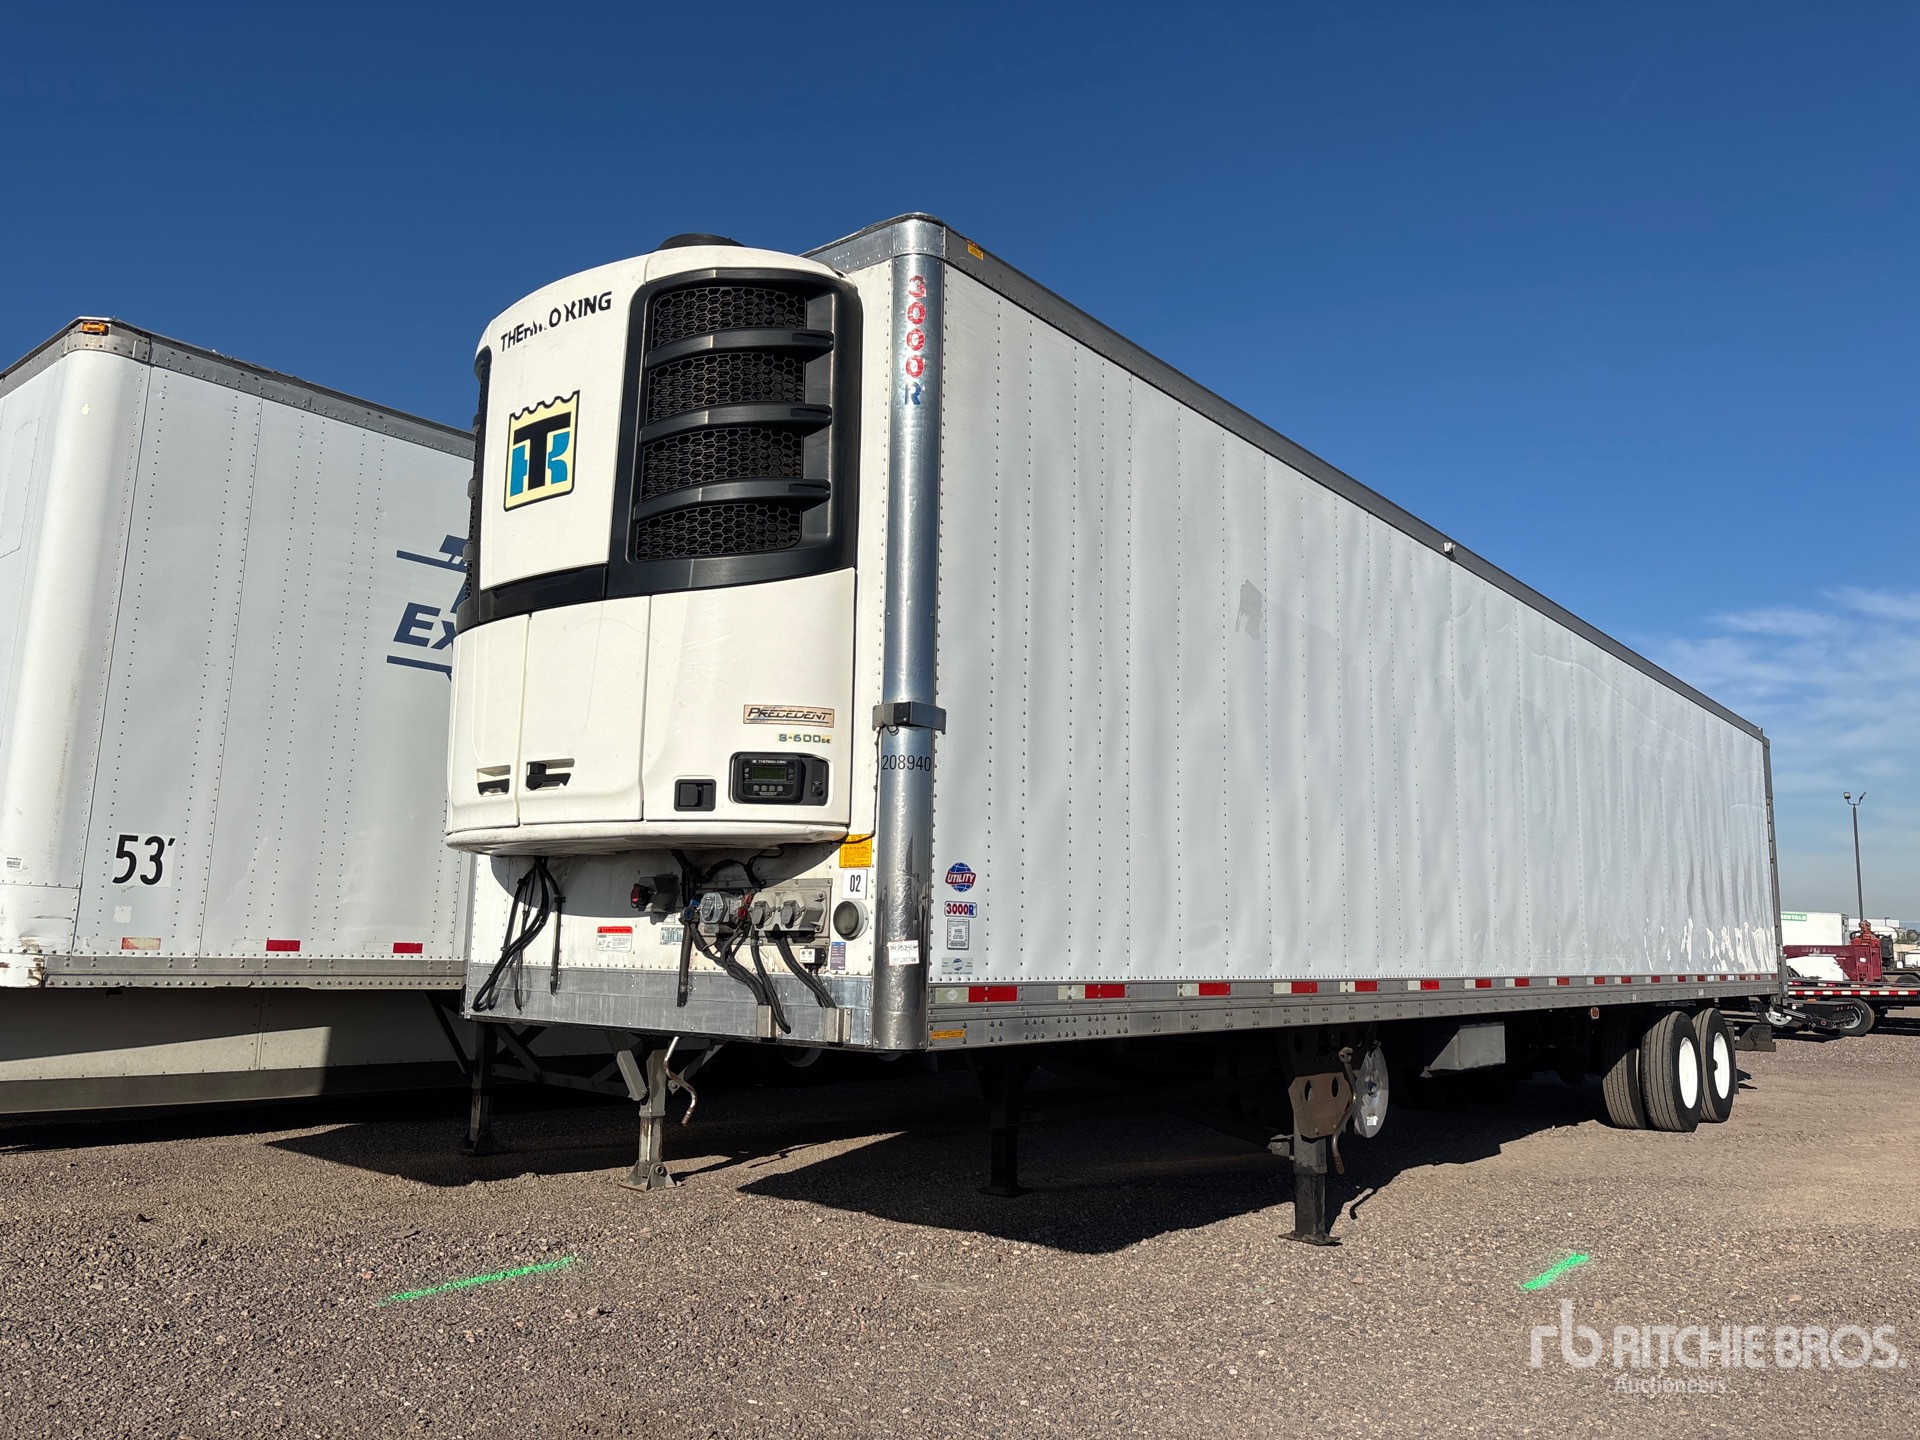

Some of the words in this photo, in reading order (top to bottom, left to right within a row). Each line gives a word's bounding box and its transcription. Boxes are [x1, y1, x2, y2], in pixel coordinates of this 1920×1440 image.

[563, 291, 613, 323] KING
[882, 754, 932, 772] 208940
[849, 874, 861, 892] 02
[947, 872, 975, 883] UTILITY
[946, 903, 974, 915] 3000R
